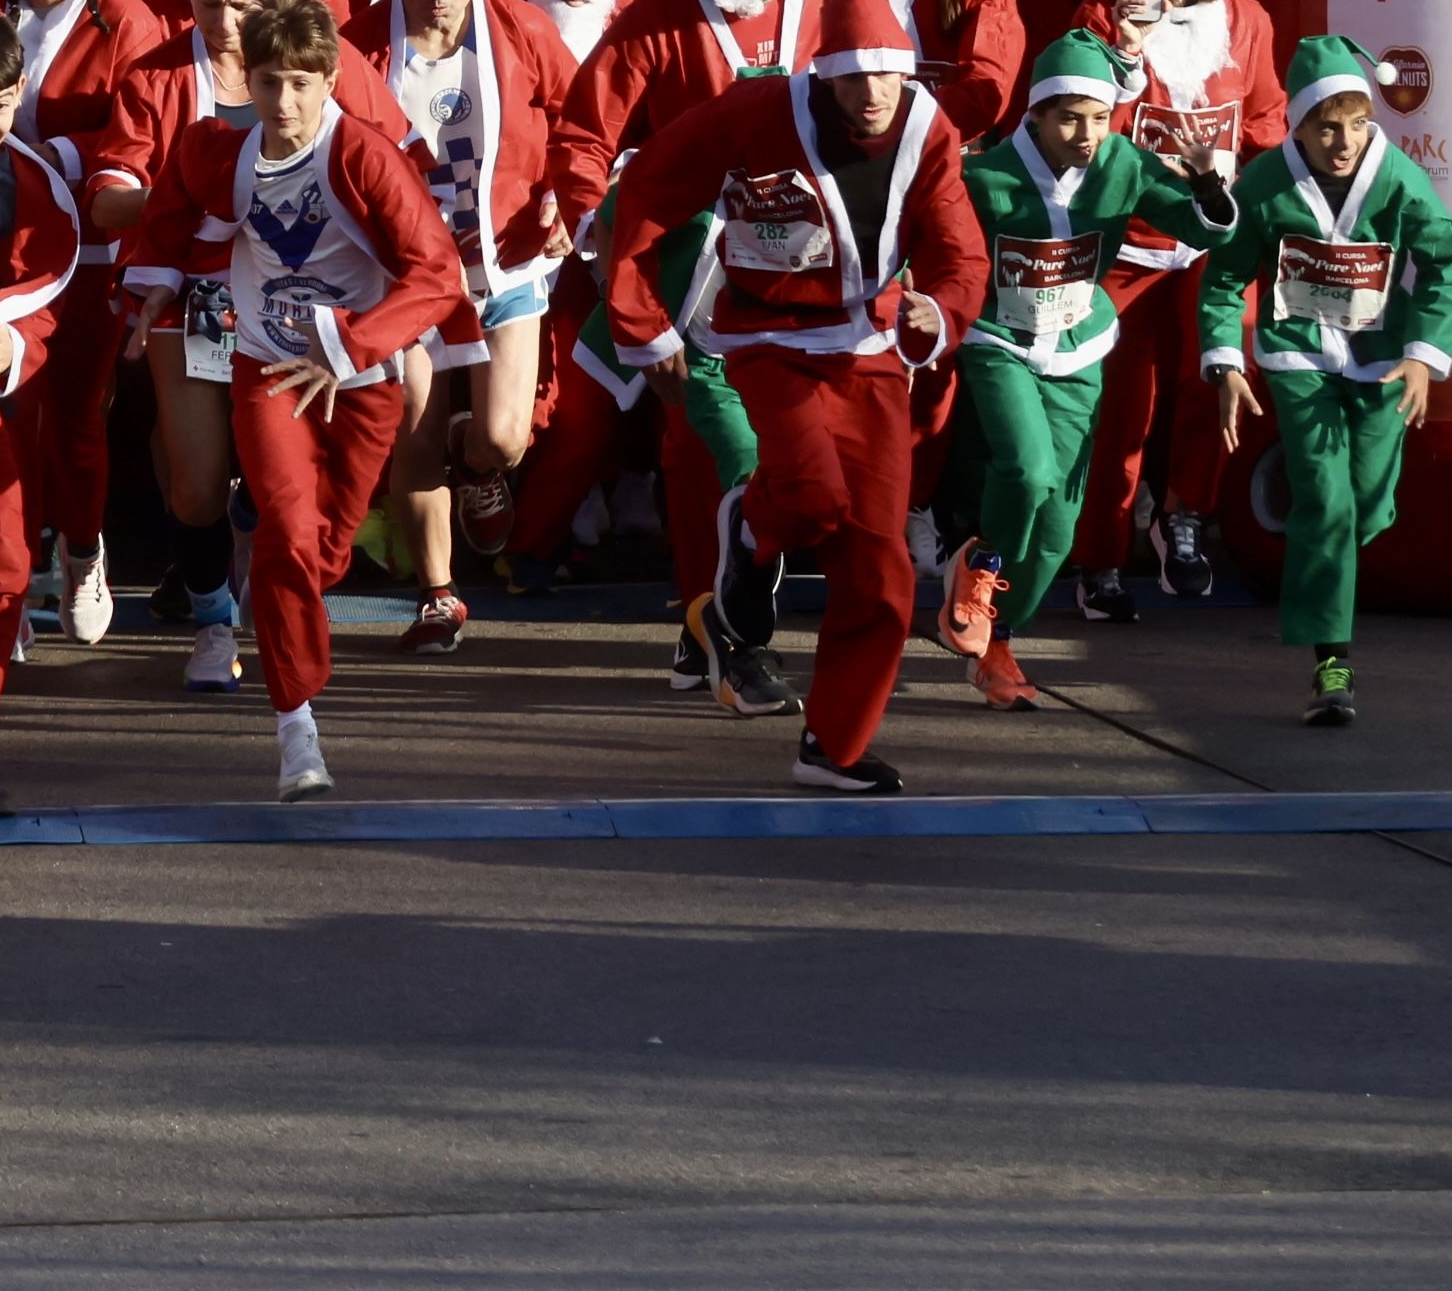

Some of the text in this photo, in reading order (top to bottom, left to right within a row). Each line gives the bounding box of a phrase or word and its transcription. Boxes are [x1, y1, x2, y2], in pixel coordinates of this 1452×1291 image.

[755, 223, 788, 240] 282
[1033, 259, 1065, 270] Pare
[1316, 259, 1384, 273] Pare Noel
[1326, 275, 1369, 284] BARCELONA
[1036, 286, 1065, 305] 967
[1028, 300, 1072, 314] GUILLEM
